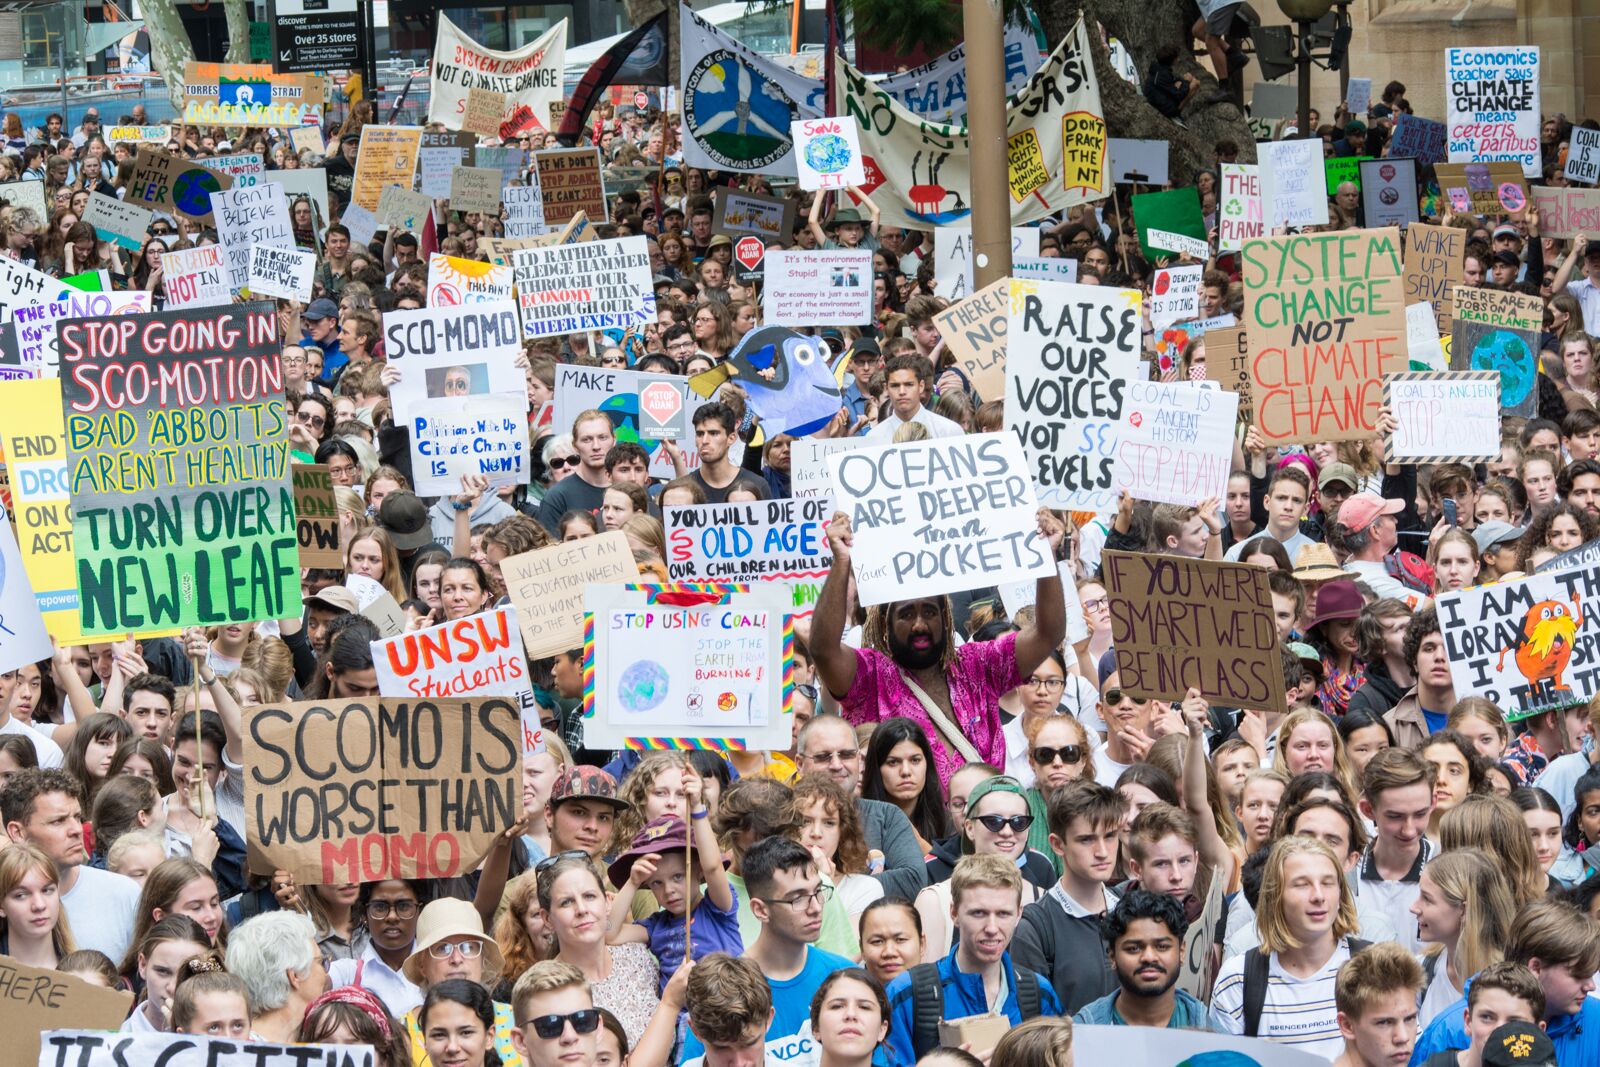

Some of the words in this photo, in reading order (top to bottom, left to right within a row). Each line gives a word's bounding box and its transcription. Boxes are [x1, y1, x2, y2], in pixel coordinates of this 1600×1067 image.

[278, 17, 307, 26] discover
[295, 35, 316, 44] Over
[317, 34, 328, 44] 35
[330, 33, 357, 42] stores
[455, 45, 500, 73] SYSTEM
[502, 49, 545, 74] CHANGE
[1450, 48, 1538, 66] Economics
[436, 62, 459, 84] NOT
[515, 68, 557, 92] CHANGE
[1450, 67, 1499, 80] teacher
[1505, 67, 1533, 80] says
[186, 85, 219, 95] TORRES
[272, 86, 303, 97] STRAIT
[1452, 80, 1534, 97] CLIMATE
[1456, 96, 1533, 113] CHANGE
[1066, 118, 1105, 134] DON'T
[1475, 110, 1516, 123] means
[803, 121, 842, 137] Save
[1452, 121, 1516, 139] ceteris
[1577, 129, 1600, 148] COAL
[1066, 133, 1103, 150] FRACK
[1450, 138, 1476, 153] ain't
[1479, 133, 1538, 156] paribus
[147, 154, 170, 169] I'M
[1014, 157, 1034, 174] NOT
[1069, 149, 1097, 165] THE
[1581, 149, 1590, 162] IS
[136, 169, 168, 184] WITH
[1010, 162, 1042, 190] MINING
[1078, 168, 1099, 184] NT
[1568, 159, 1599, 179] OVER!
[820, 174, 844, 187] IT
[1019, 173, 1048, 198] RIGHTS
[131, 181, 169, 203] HER
[740, 243, 759, 251] #STOP
[1412, 228, 1462, 258] WAKE
[255, 247, 269, 258] THE
[270, 248, 303, 265] OCEANS
[519, 251, 538, 267] I'D
[544, 245, 608, 263] RATHER
[614, 242, 625, 256] A
[742, 251, 760, 259] ADANI
[784, 255, 801, 264] It's
[804, 255, 818, 264] the
[821, 255, 871, 264] environment
[1242, 234, 1400, 289] SYSTEM
[252, 267, 262, 277] SO
[263, 270, 276, 282] ARE
[253, 257, 267, 269] ARE
[268, 260, 292, 275] RISING
[515, 262, 574, 281] SLEDGE
[577, 253, 650, 274] HAMMER
[1421, 258, 1448, 278] UP!
[517, 275, 592, 295] THROUGH
[596, 271, 628, 286] OUR
[1172, 273, 1200, 283] DENYING
[521, 288, 592, 308] ECONOMY
[595, 284, 640, 300] THAN
[778, 302, 792, 310] part
[789, 292, 817, 300] economy
[828, 291, 842, 300] just
[1153, 302, 1163, 313] IS
[1169, 298, 1194, 312] DYING
[1254, 279, 1391, 329] CHANGE
[1455, 288, 1496, 303] THERE
[1502, 294, 1525, 309] ARE
[1527, 300, 1544, 313] NO
[522, 302, 596, 321] THROUGH
[598, 299, 634, 314] OUR
[525, 318, 578, 336] SHEER
[581, 291, 656, 329] EXISTENCE
[798, 311, 818, 319] policy
[1454, 300, 1487, 311] JOBS
[1490, 303, 1506, 313] ON
[1508, 307, 1517, 317] A
[1460, 309, 1488, 322] DEAD
[1491, 312, 1542, 329] PLANET
[1023, 294, 1137, 352] RAISE
[1291, 317, 1354, 347] NOT
[61, 319, 138, 363] STOP
[142, 314, 241, 355] GOING
[246, 311, 280, 345] IN
[387, 311, 517, 360] SCO-MOMO
[1041, 342, 1110, 380] OUR
[1252, 337, 1398, 390] CLIMATE
[70, 353, 285, 414] SCO-MOTION
[561, 370, 616, 392] MAKE
[648, 391, 674, 400] #STOP
[649, 400, 674, 410] ADANI
[1014, 375, 1127, 420] VOICES
[1131, 383, 1182, 407] COAL
[1196, 391, 1212, 412] IS
[68, 409, 137, 454] BAD
[146, 400, 286, 447] 'ABBOTTS
[1154, 408, 1201, 429] ANCIENT
[1012, 421, 1066, 453] NOT
[1152, 426, 1199, 444] HISTORY
[72, 447, 177, 495] AREN'T
[186, 439, 289, 488] HEALTHY
[838, 439, 1009, 498] OCEANS
[1118, 440, 1172, 491] STOP
[1170, 448, 1229, 497] ADANI
[671, 508, 708, 528] YOU
[711, 502, 760, 527] WILL
[768, 501, 796, 522] DIE
[802, 499, 830, 521] OF
[852, 495, 906, 533] ARE
[917, 475, 1029, 522] DEEPER
[76, 494, 184, 551] TURN
[194, 486, 276, 542] OVER
[280, 491, 296, 533] A
[701, 524, 753, 560] OLD
[763, 521, 819, 556] AGE
[892, 529, 1044, 585] POCKETS
[78, 551, 181, 631] NEW
[194, 537, 297, 624] LEAF
[1107, 554, 1134, 593] IF
[1141, 556, 1192, 597] YOU
[1198, 563, 1273, 608] WERE
[1441, 597, 1466, 629] I
[1479, 582, 1537, 621] AM
[611, 612, 654, 629] STOP
[662, 610, 711, 629] USING
[720, 611, 767, 630] COAL!
[1108, 598, 1206, 647] SMART
[1210, 605, 1275, 652] WE'D
[385, 610, 510, 677] UNSW
[697, 639, 731, 650] STOP
[737, 637, 762, 649] THE
[1445, 615, 1531, 662] LORAX
[694, 653, 734, 667] EARTH
[406, 655, 523, 698] Students
[695, 667, 751, 681] BURNING
[1116, 649, 1154, 693] BE
[1157, 652, 1178, 694] IN
[1180, 655, 1270, 703] CLASS
[250, 701, 443, 785] SCOMO
[461, 700, 519, 775] IS
[255, 778, 400, 848] WORSE
[406, 777, 517, 834] THAN
[320, 832, 460, 885] MOMO
